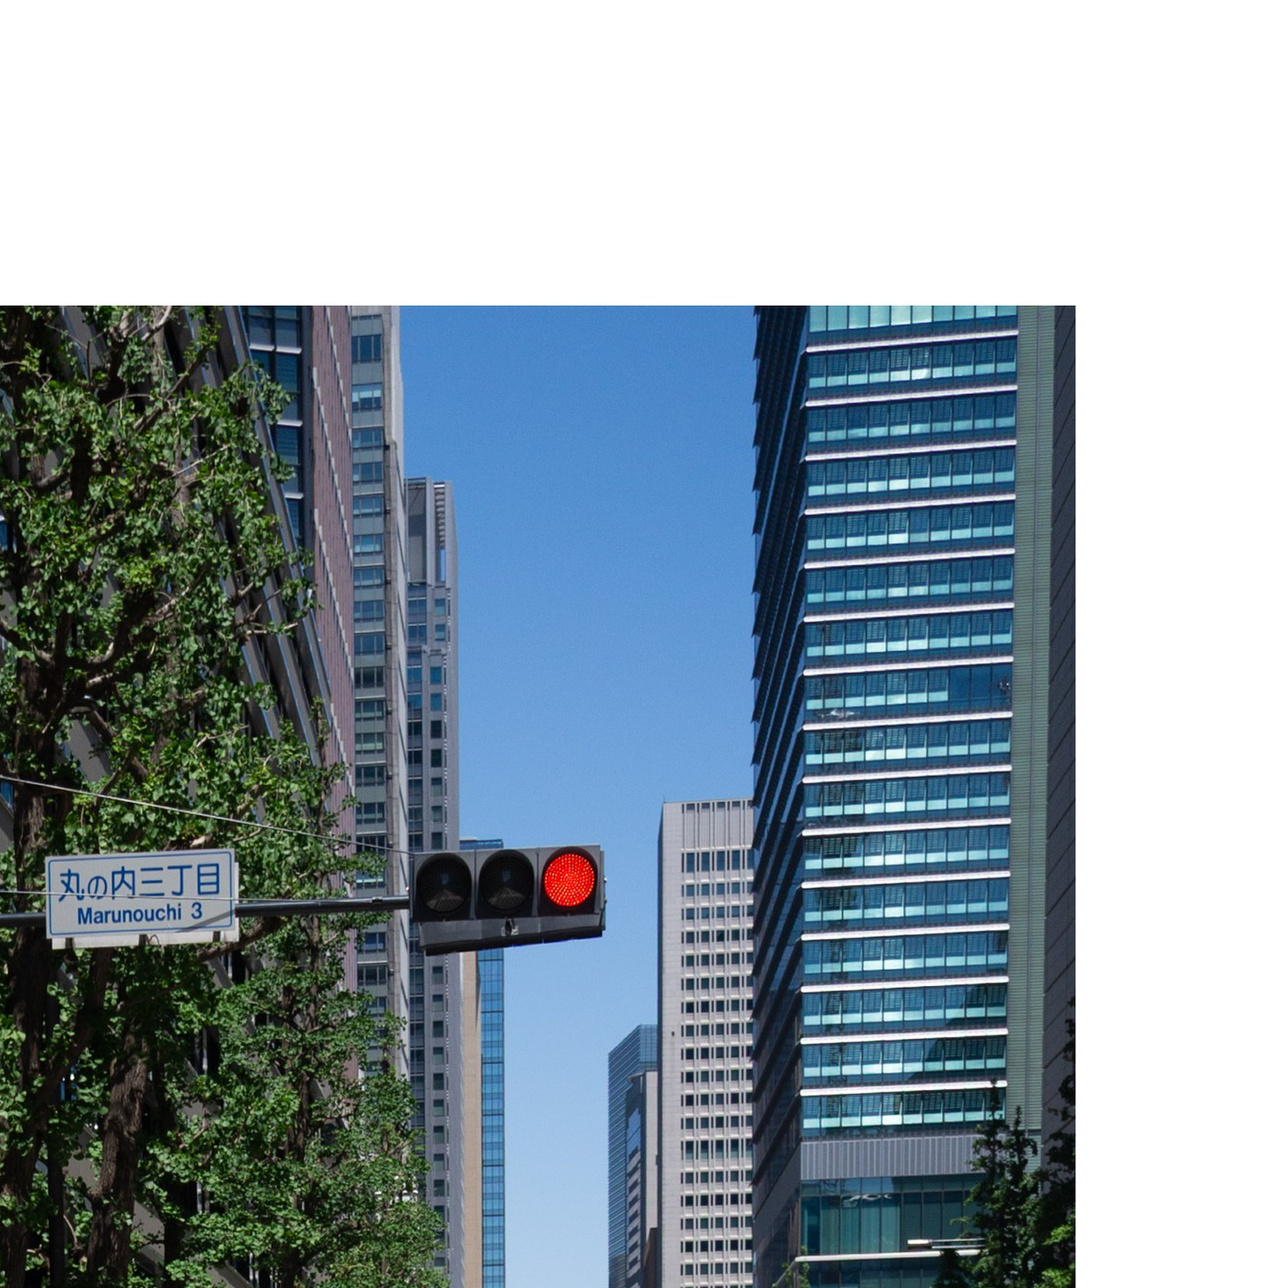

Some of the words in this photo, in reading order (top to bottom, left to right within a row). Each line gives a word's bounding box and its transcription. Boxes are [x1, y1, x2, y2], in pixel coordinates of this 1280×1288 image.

[58, 863, 220, 902] 丸の内三丁目
[77, 902, 182, 925] Marunouchi
[191, 902, 203, 920] 3
